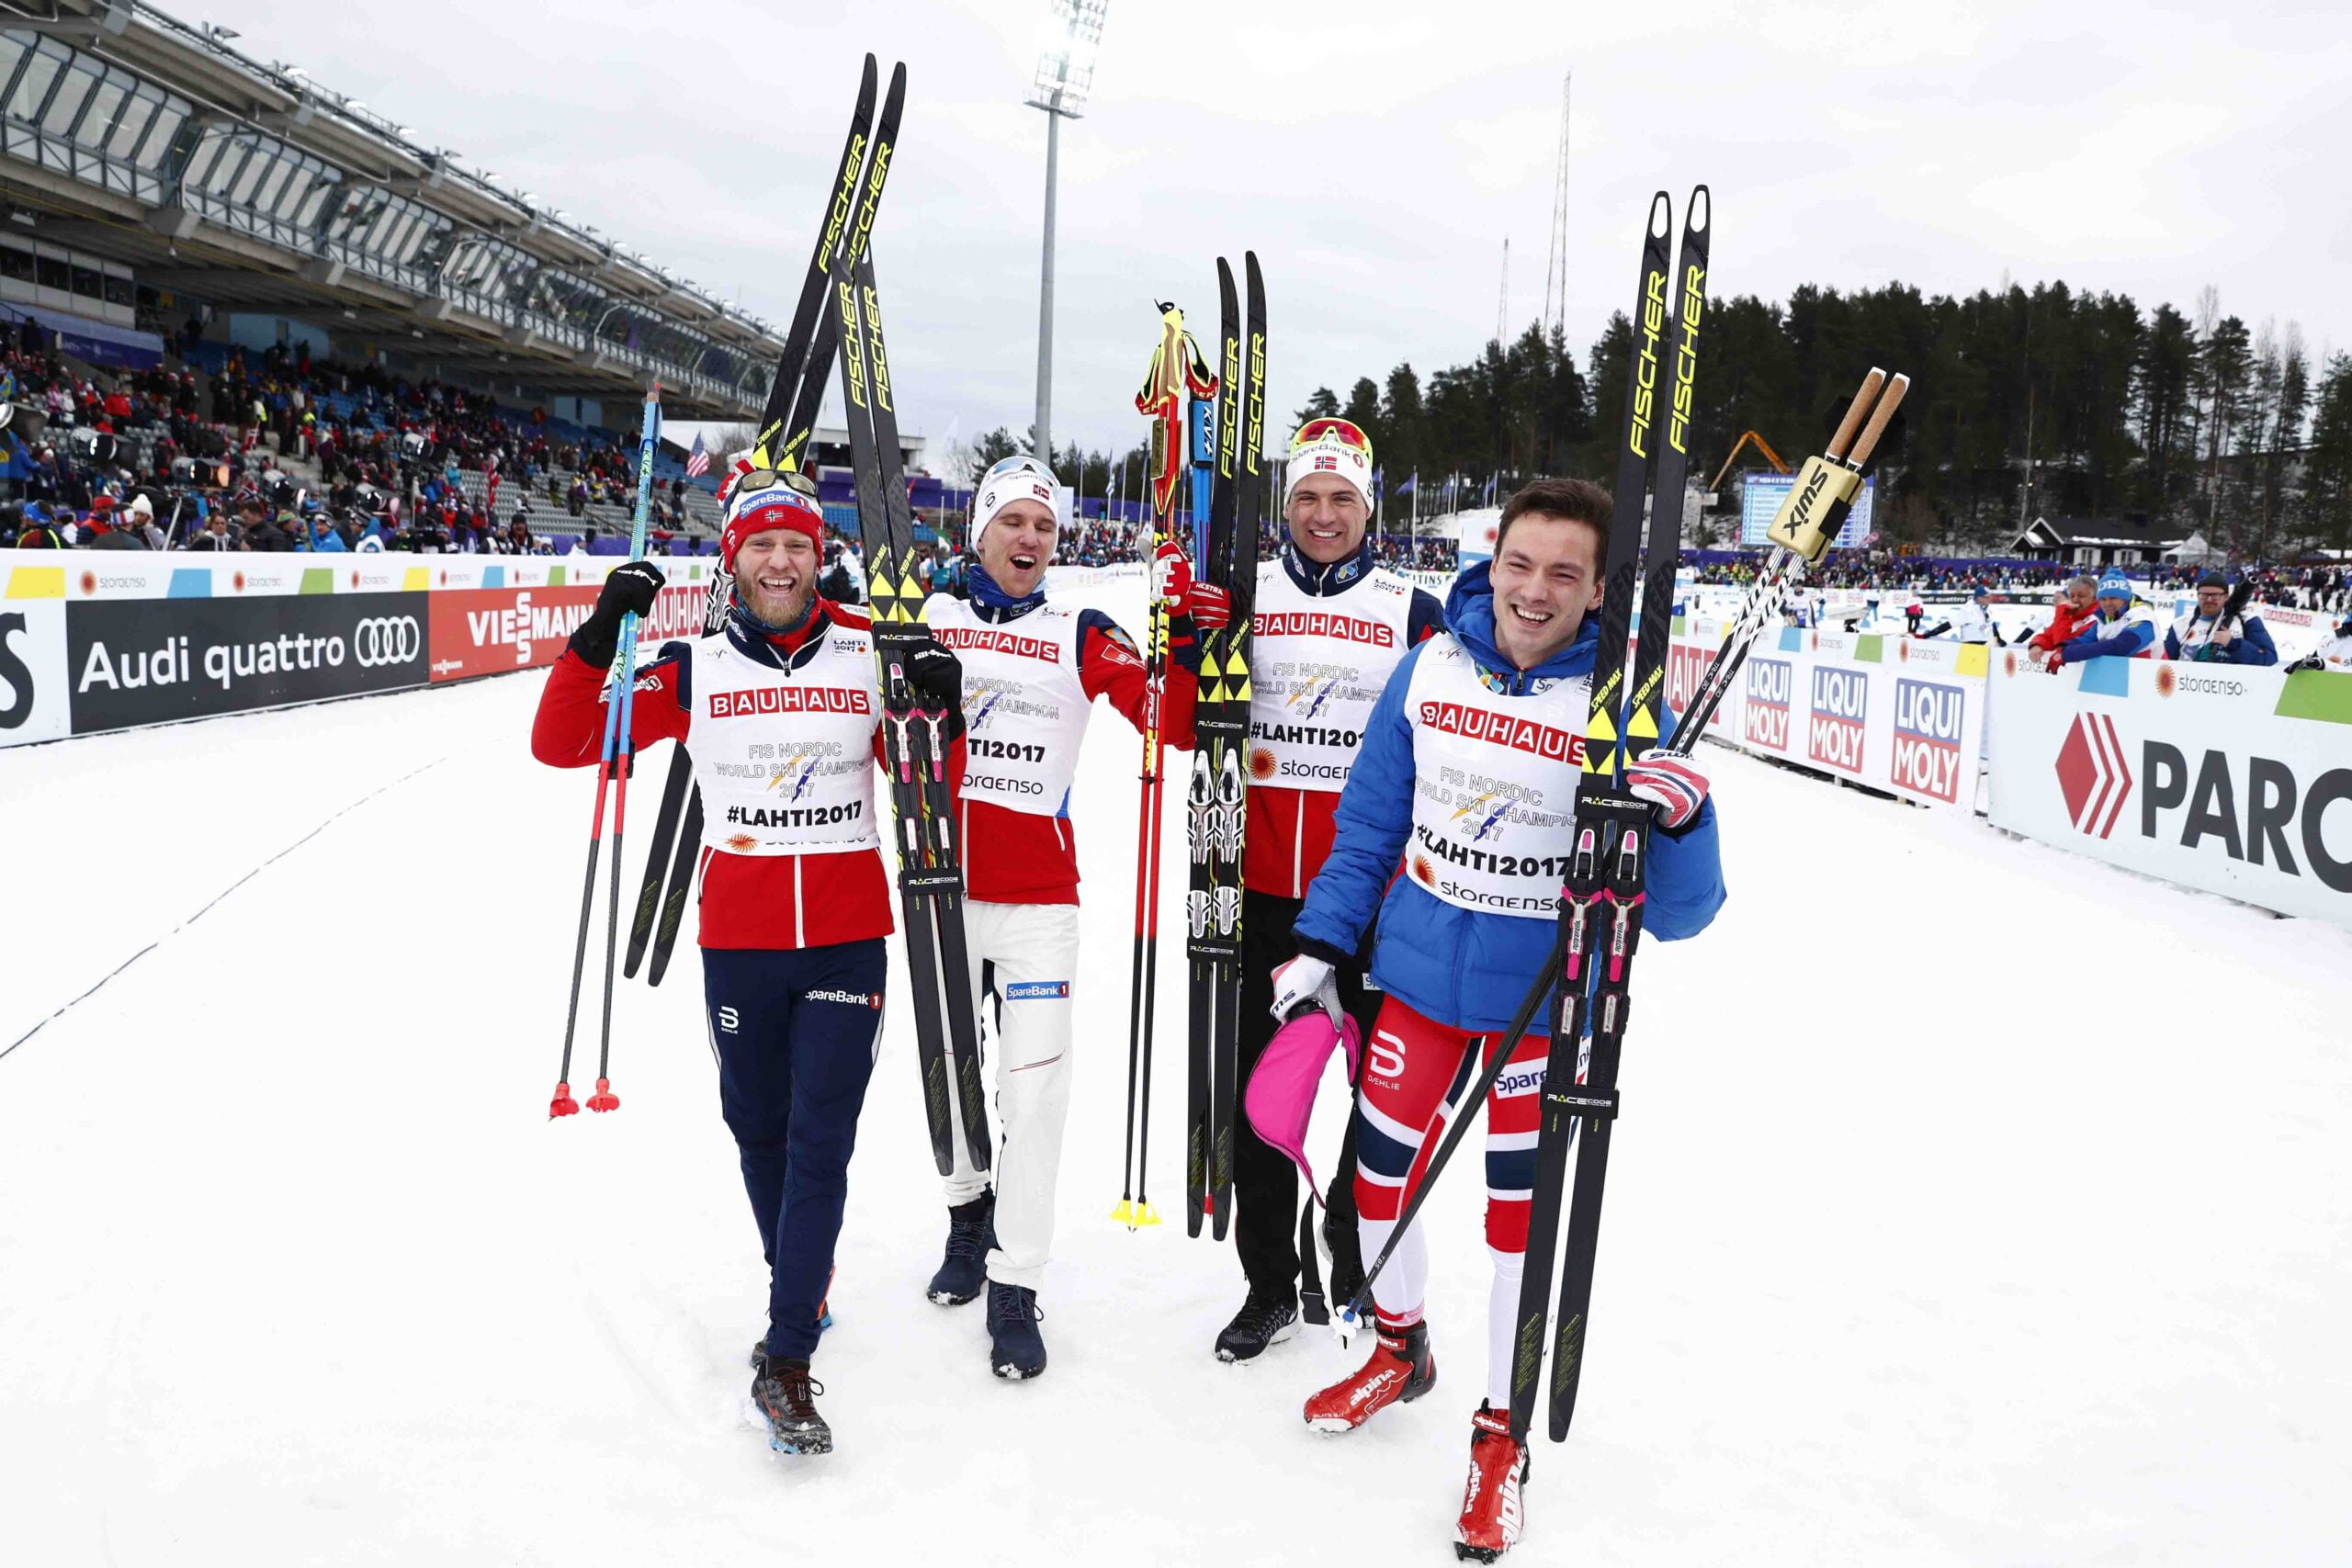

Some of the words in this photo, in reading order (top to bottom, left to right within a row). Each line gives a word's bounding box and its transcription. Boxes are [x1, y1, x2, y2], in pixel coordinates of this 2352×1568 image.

[819, 134, 866, 274] FISCHER
[840, 281, 866, 408] FISCHER
[864, 286, 892, 412] FISCHER
[1630, 270, 1667, 459] FISCHER
[1669, 265, 1706, 455] FISCHER
[1221, 337, 1238, 479] FISCHER
[1247, 333, 1265, 476] FISCHER
[741, 493, 795, 515] SpareBank
[1195, 582, 1224, 596] HESTRA
[1253, 615, 1391, 644] BAUHAUS
[78, 636, 189, 693] Audi
[204, 633, 345, 689] quattro
[1272, 662, 1295, 677] FIS
[1299, 663, 1359, 682] NORDIC
[1747, 659, 1791, 704] LIQUI
[712, 691, 867, 715] BAUHAUS
[965, 677, 1022, 695] NORDIC
[1289, 681, 1314, 696] SKI
[1591, 687, 1609, 712] SPEED
[1607, 667, 1623, 691] MAX
[1632, 682, 1649, 708] SPEED
[1646, 664, 1665, 689] MAX
[1814, 666, 1864, 719] LIQUI
[2178, 675, 2245, 696] storaenso
[1295, 701, 1330, 717] 2017
[1747, 705, 1789, 752] MOLY
[1897, 681, 1962, 741] LIQUI
[749, 743, 775, 759] FIS
[779, 742, 842, 758] NORDIC
[1422, 704, 1586, 761] BAUHAUS
[1811, 717, 1863, 772] MOLY
[713, 761, 765, 779] WORLD
[770, 762, 797, 778] SKI
[1440, 765, 1465, 788] FIS
[1469, 775, 1544, 807] NORDIC
[1894, 737, 1959, 797] MOLY
[779, 783, 815, 798] 2017
[1455, 792, 1486, 816] SKI
[726, 800, 862, 828] #LAHTI2017
[1461, 818, 1504, 841] 2017
[1417, 824, 1569, 877] #LAHTI2017
[1008, 985, 1058, 998] SpareBank
[1350, 1369, 1396, 1406] alpina
[1474, 1415, 1506, 1431] alpina
